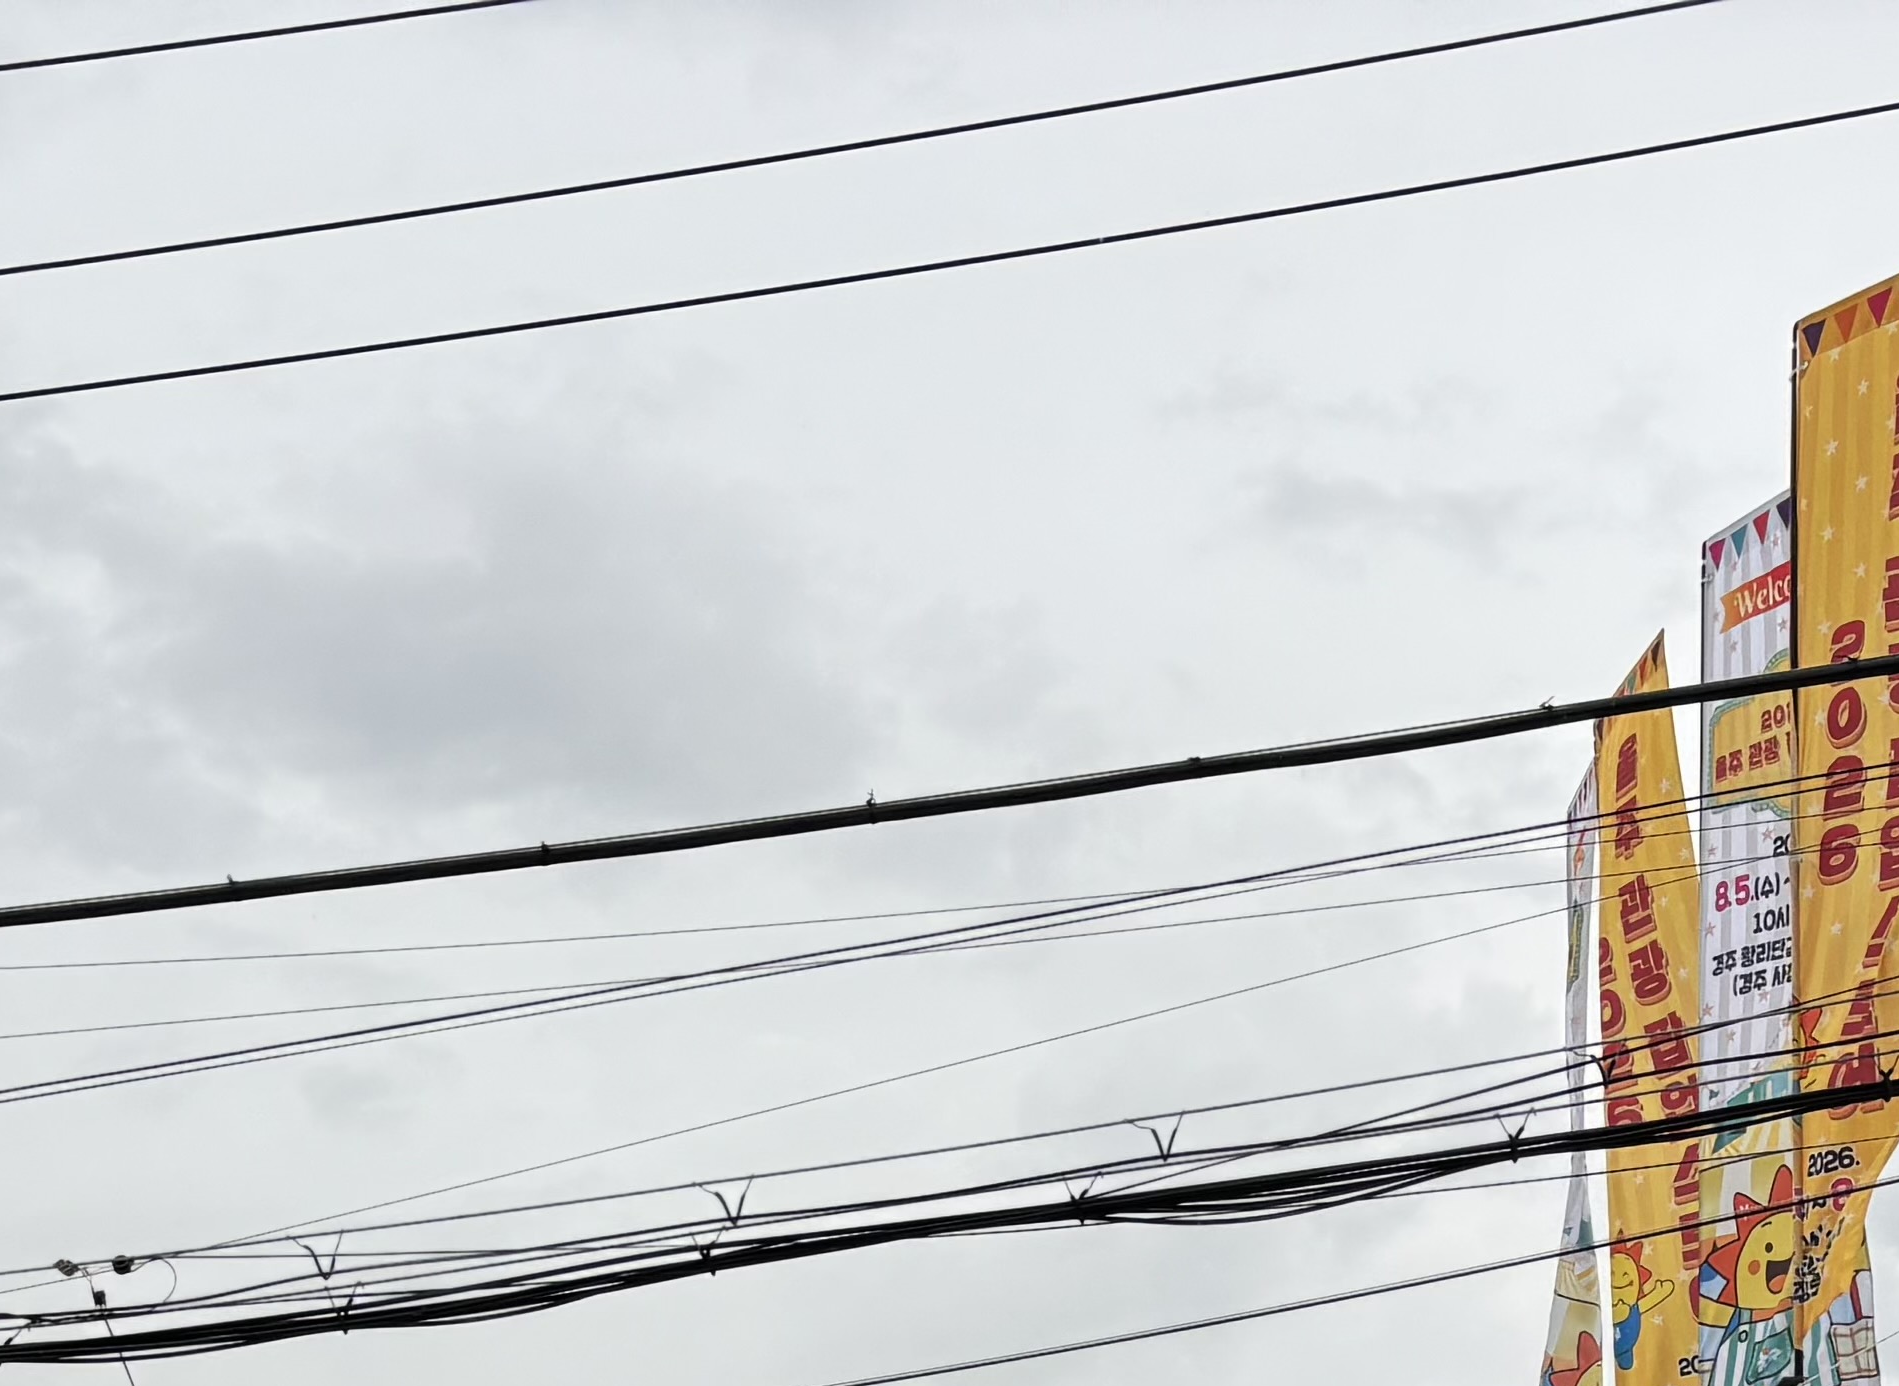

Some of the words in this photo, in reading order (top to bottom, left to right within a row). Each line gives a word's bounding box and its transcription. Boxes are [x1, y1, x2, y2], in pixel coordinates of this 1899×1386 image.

[1817, 620, 1867, 886] 2026
[1618, 873, 1673, 1006] 관광
[1712, 950, 1737, 976] 경주
